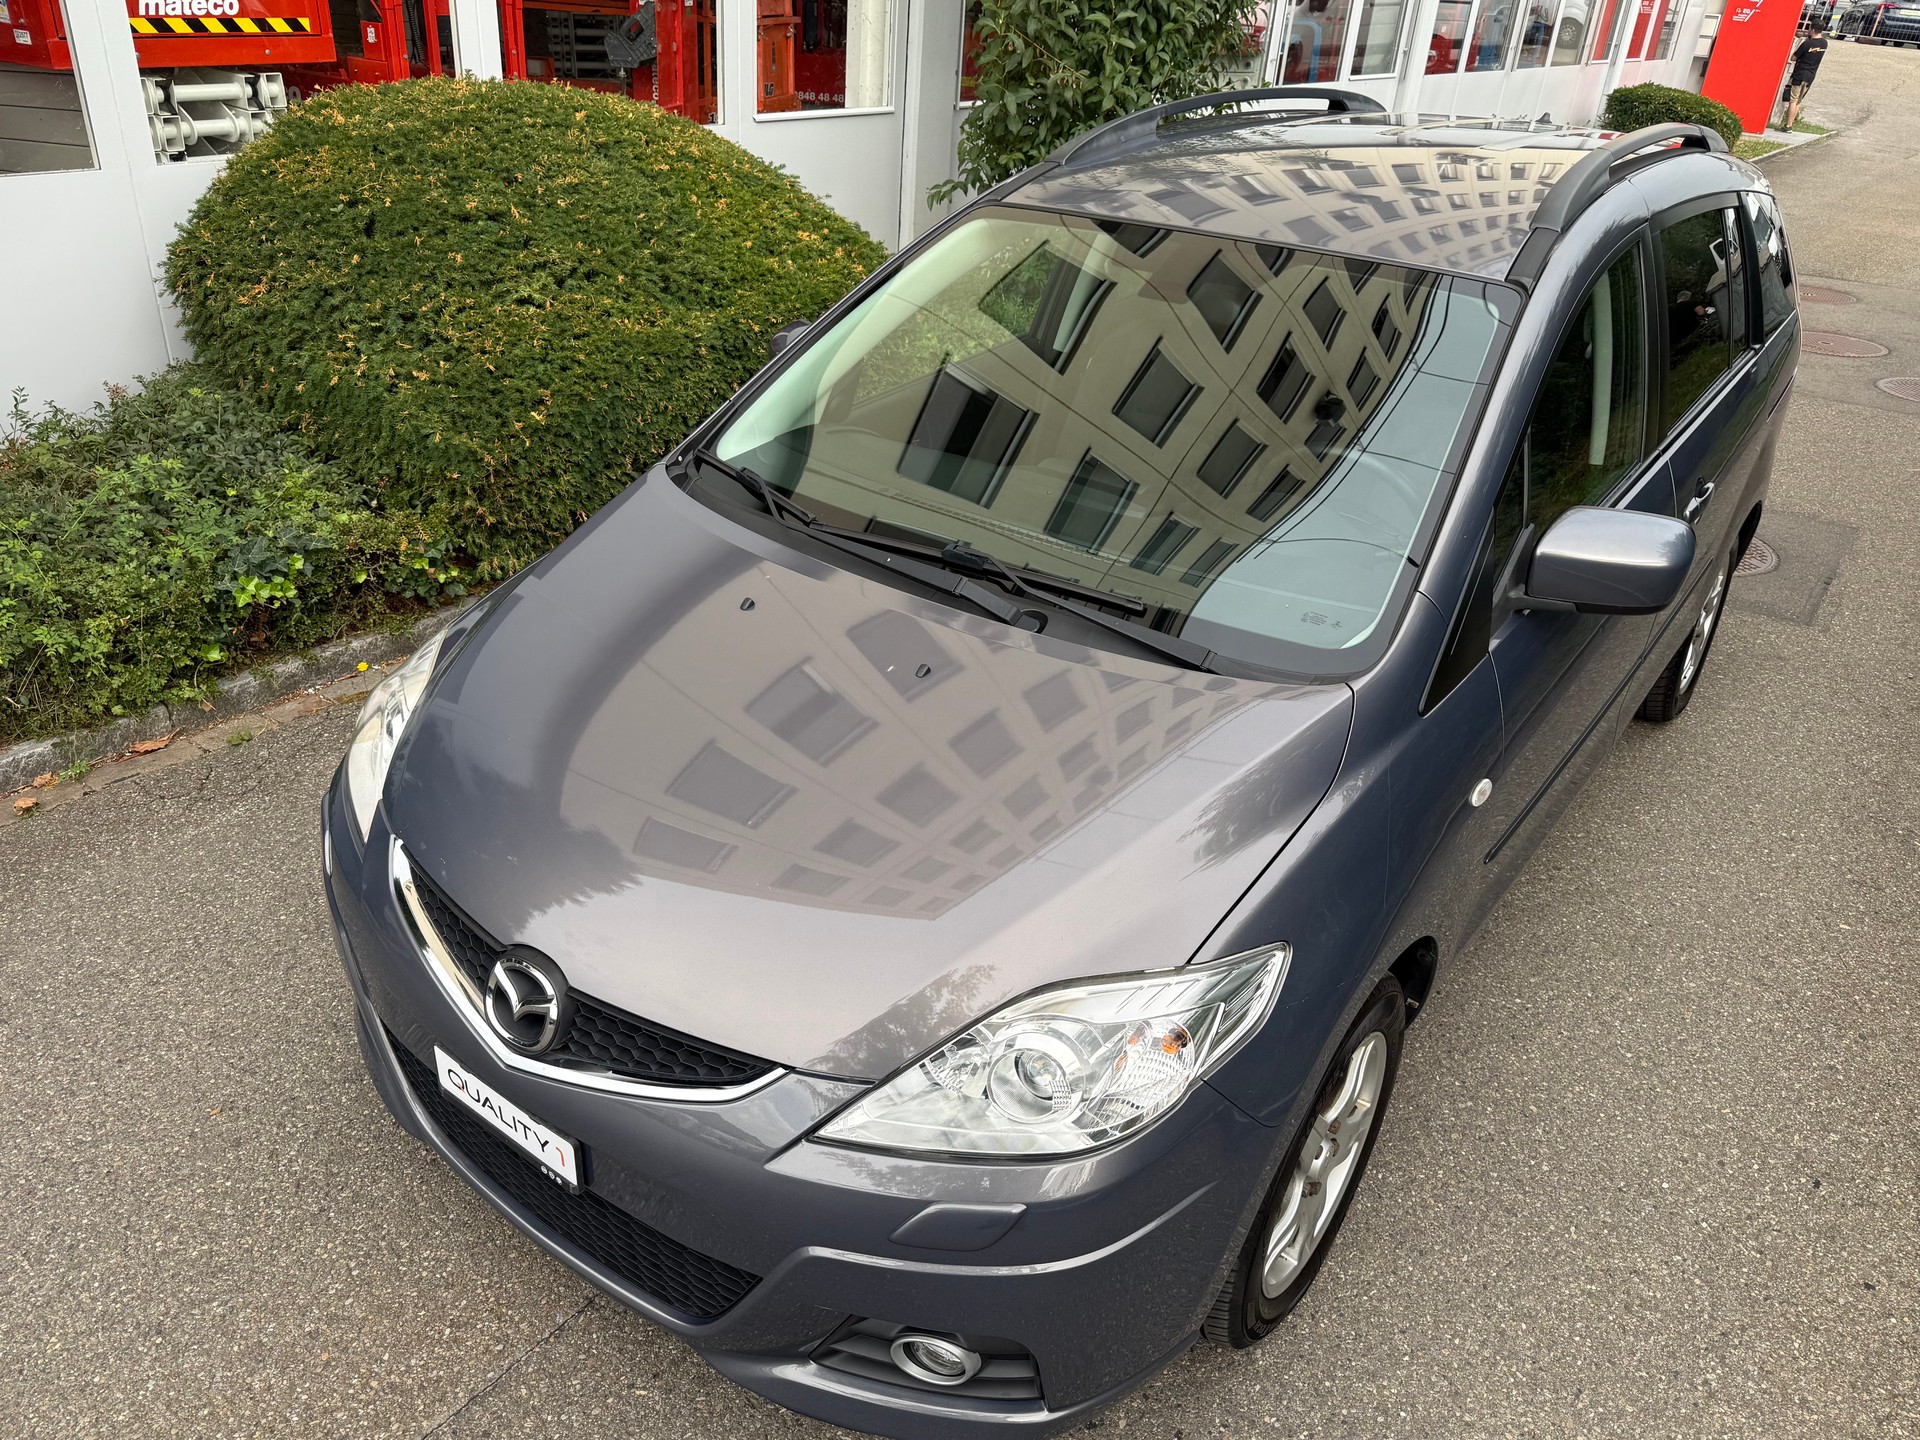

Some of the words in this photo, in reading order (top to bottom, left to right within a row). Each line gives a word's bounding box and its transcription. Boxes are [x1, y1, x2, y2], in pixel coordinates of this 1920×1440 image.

[138, 0, 240, 16] mateco
[818, 92, 830, 101] 48
[832, 94, 844, 103] 48
